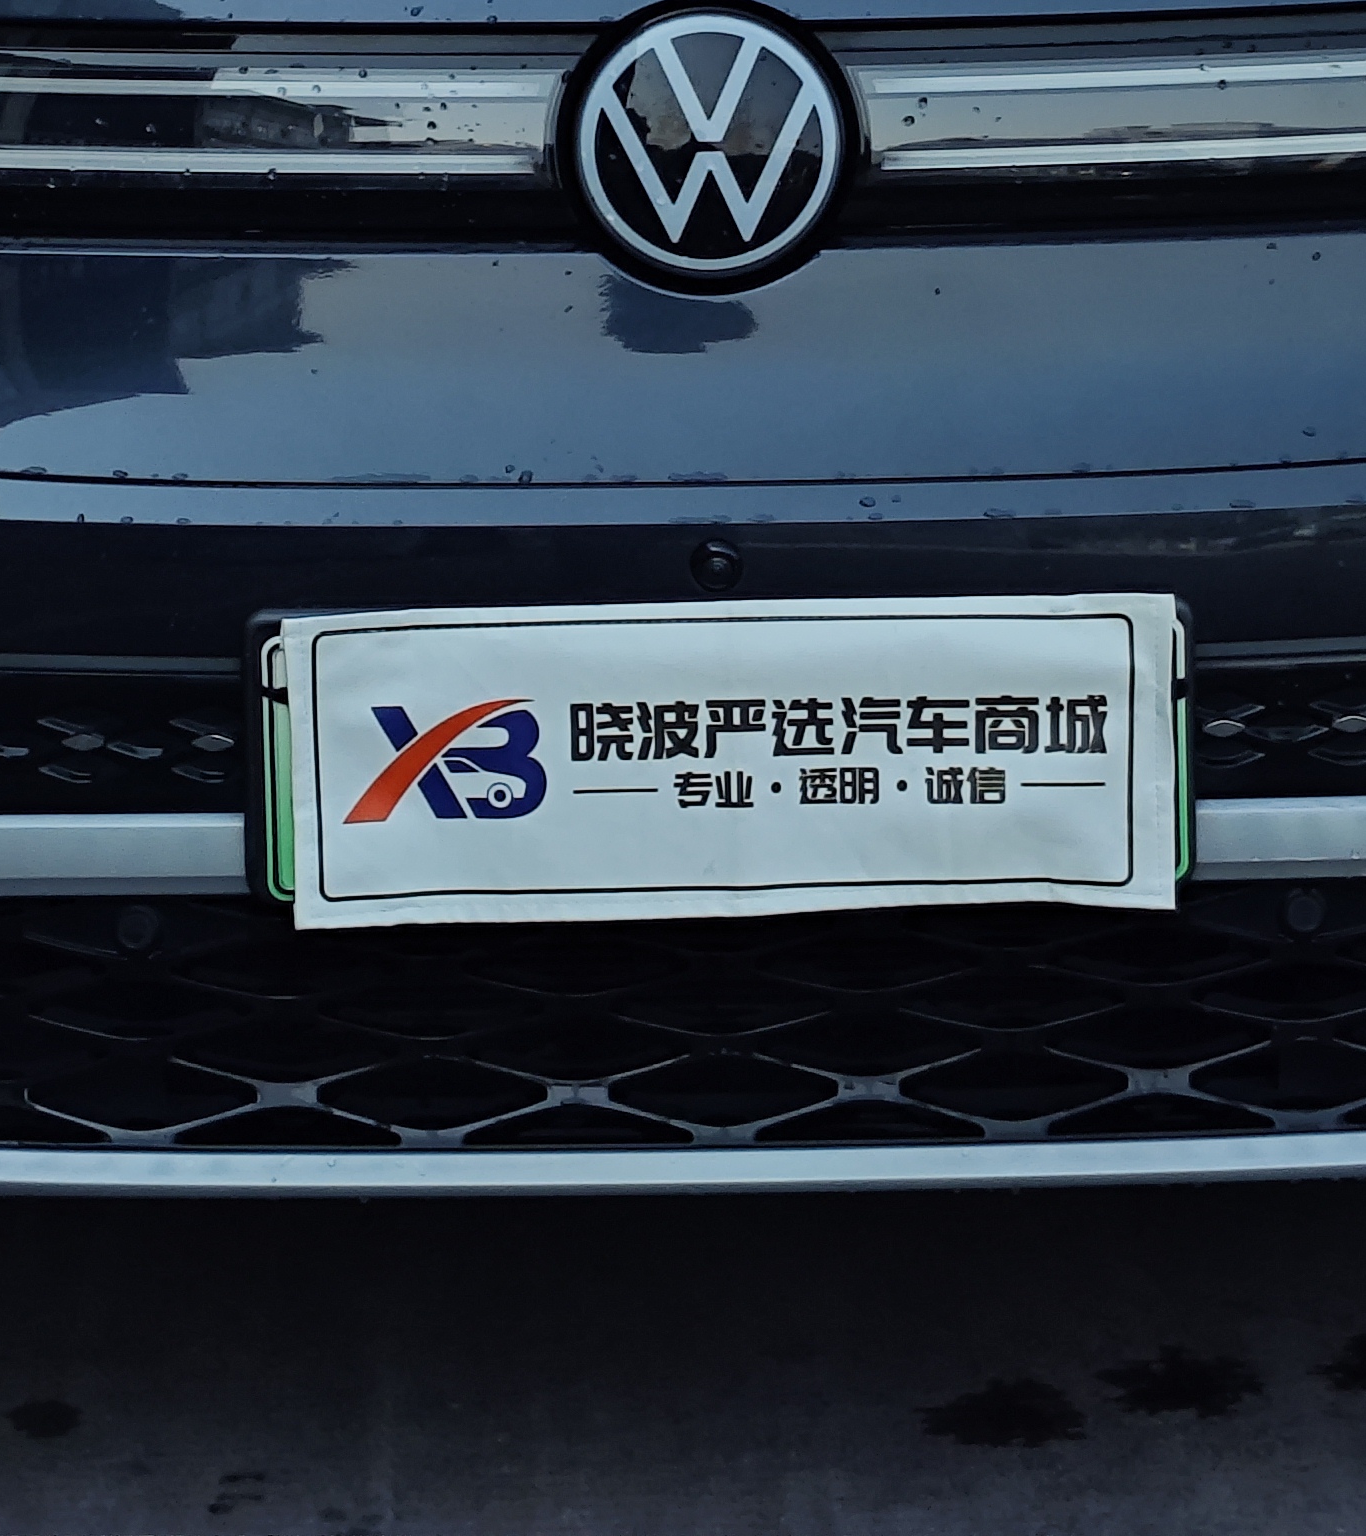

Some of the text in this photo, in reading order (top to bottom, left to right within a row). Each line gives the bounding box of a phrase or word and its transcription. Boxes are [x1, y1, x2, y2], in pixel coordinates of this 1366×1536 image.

[570, 695, 1108, 762] 晓波严选汽车商城
